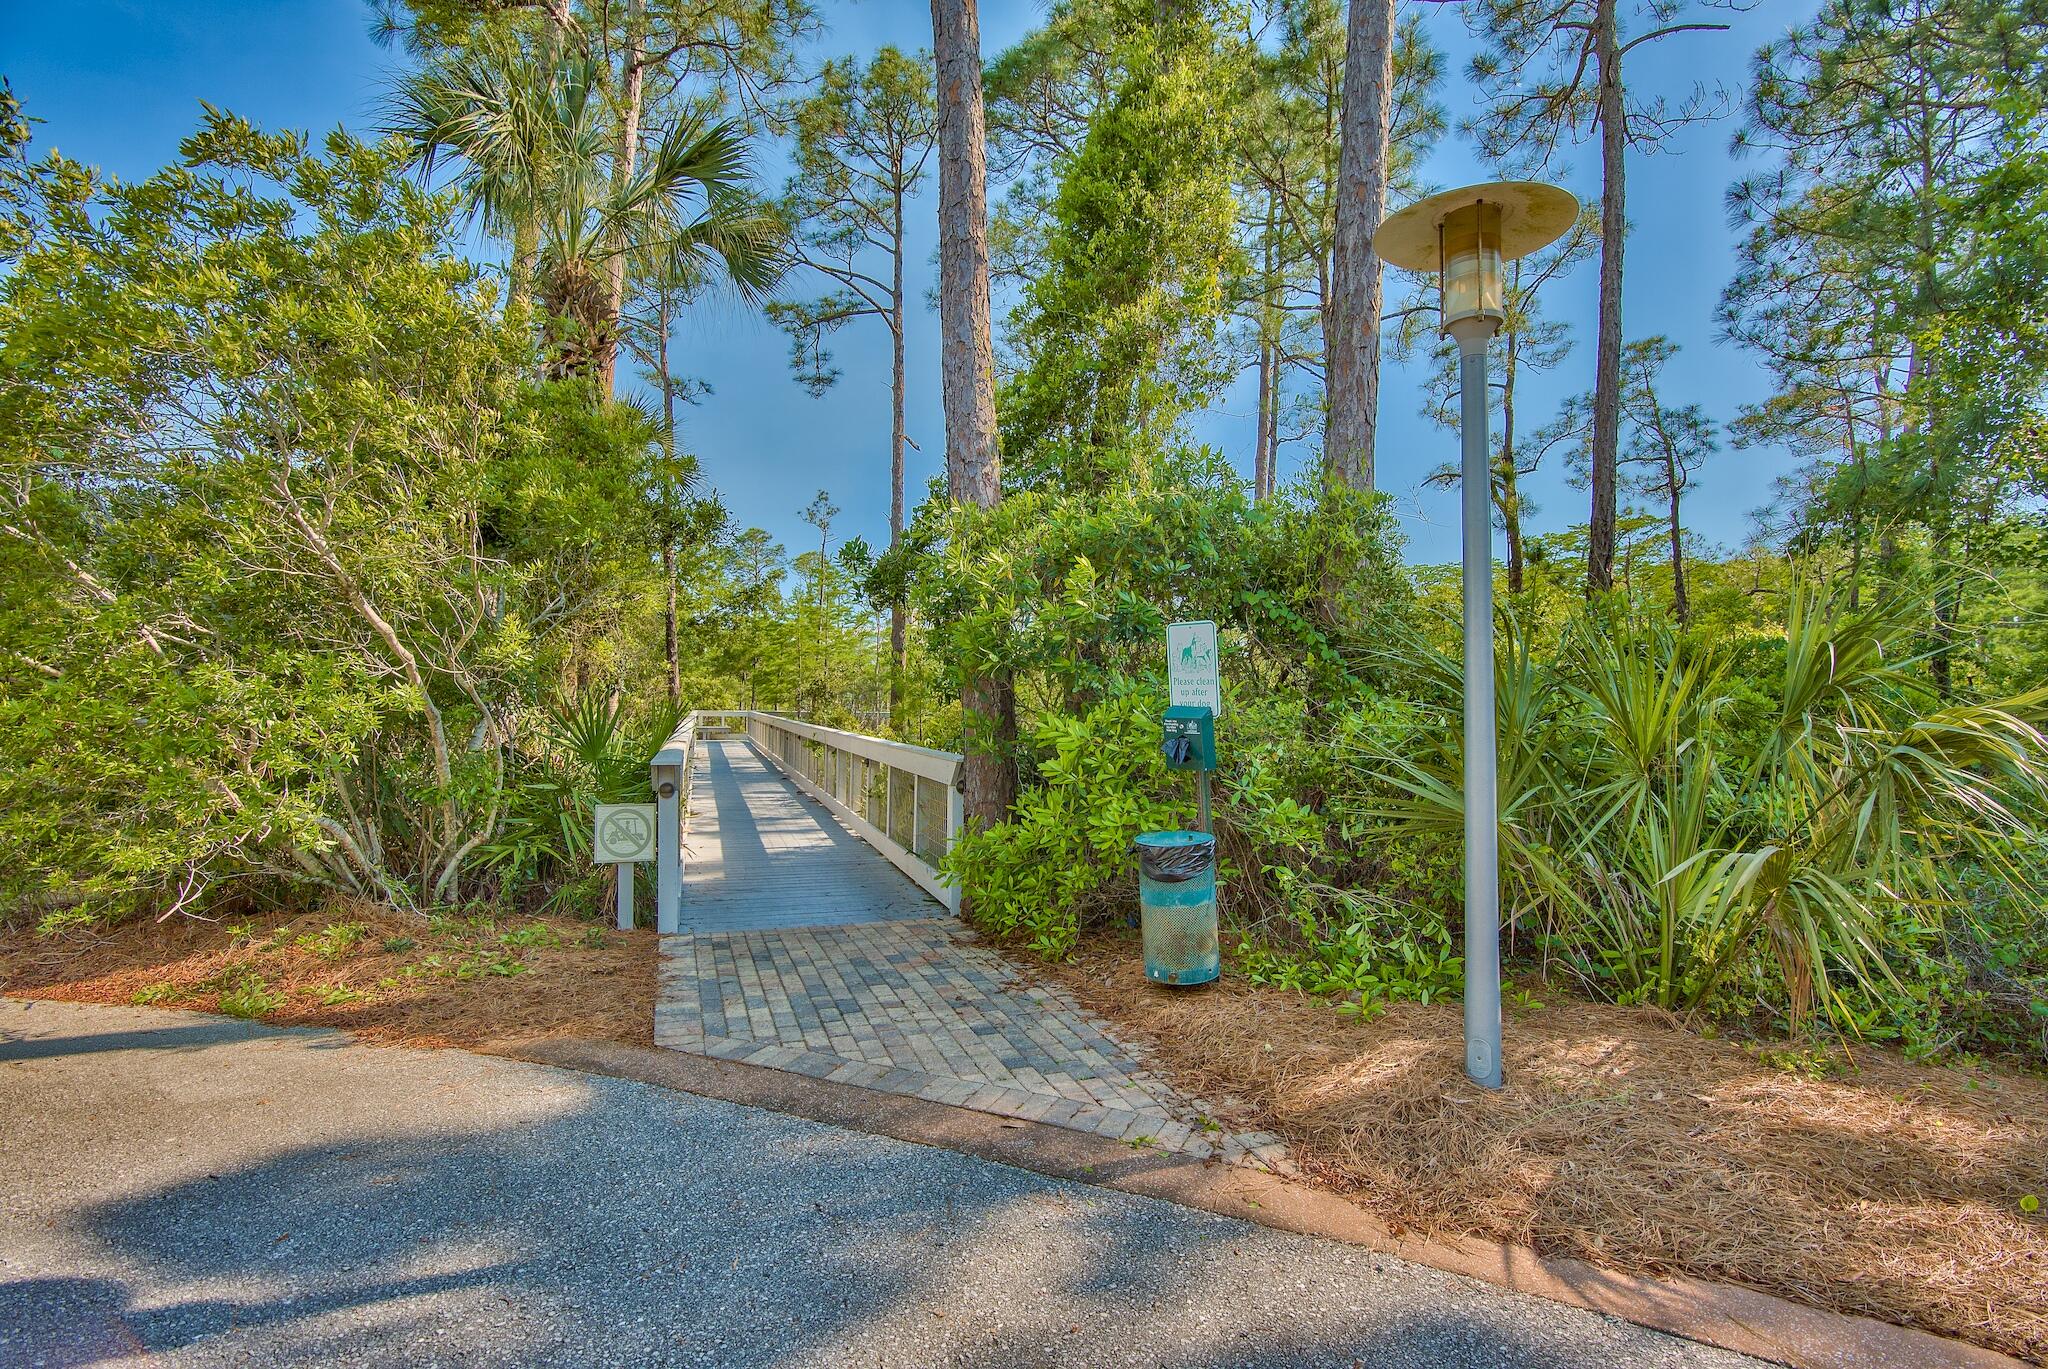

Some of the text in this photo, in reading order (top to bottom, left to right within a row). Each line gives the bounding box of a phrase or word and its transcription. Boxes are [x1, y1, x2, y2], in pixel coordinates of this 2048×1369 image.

[1173, 677, 1215, 686] Please clean
[1180, 687, 1208, 697] up after
